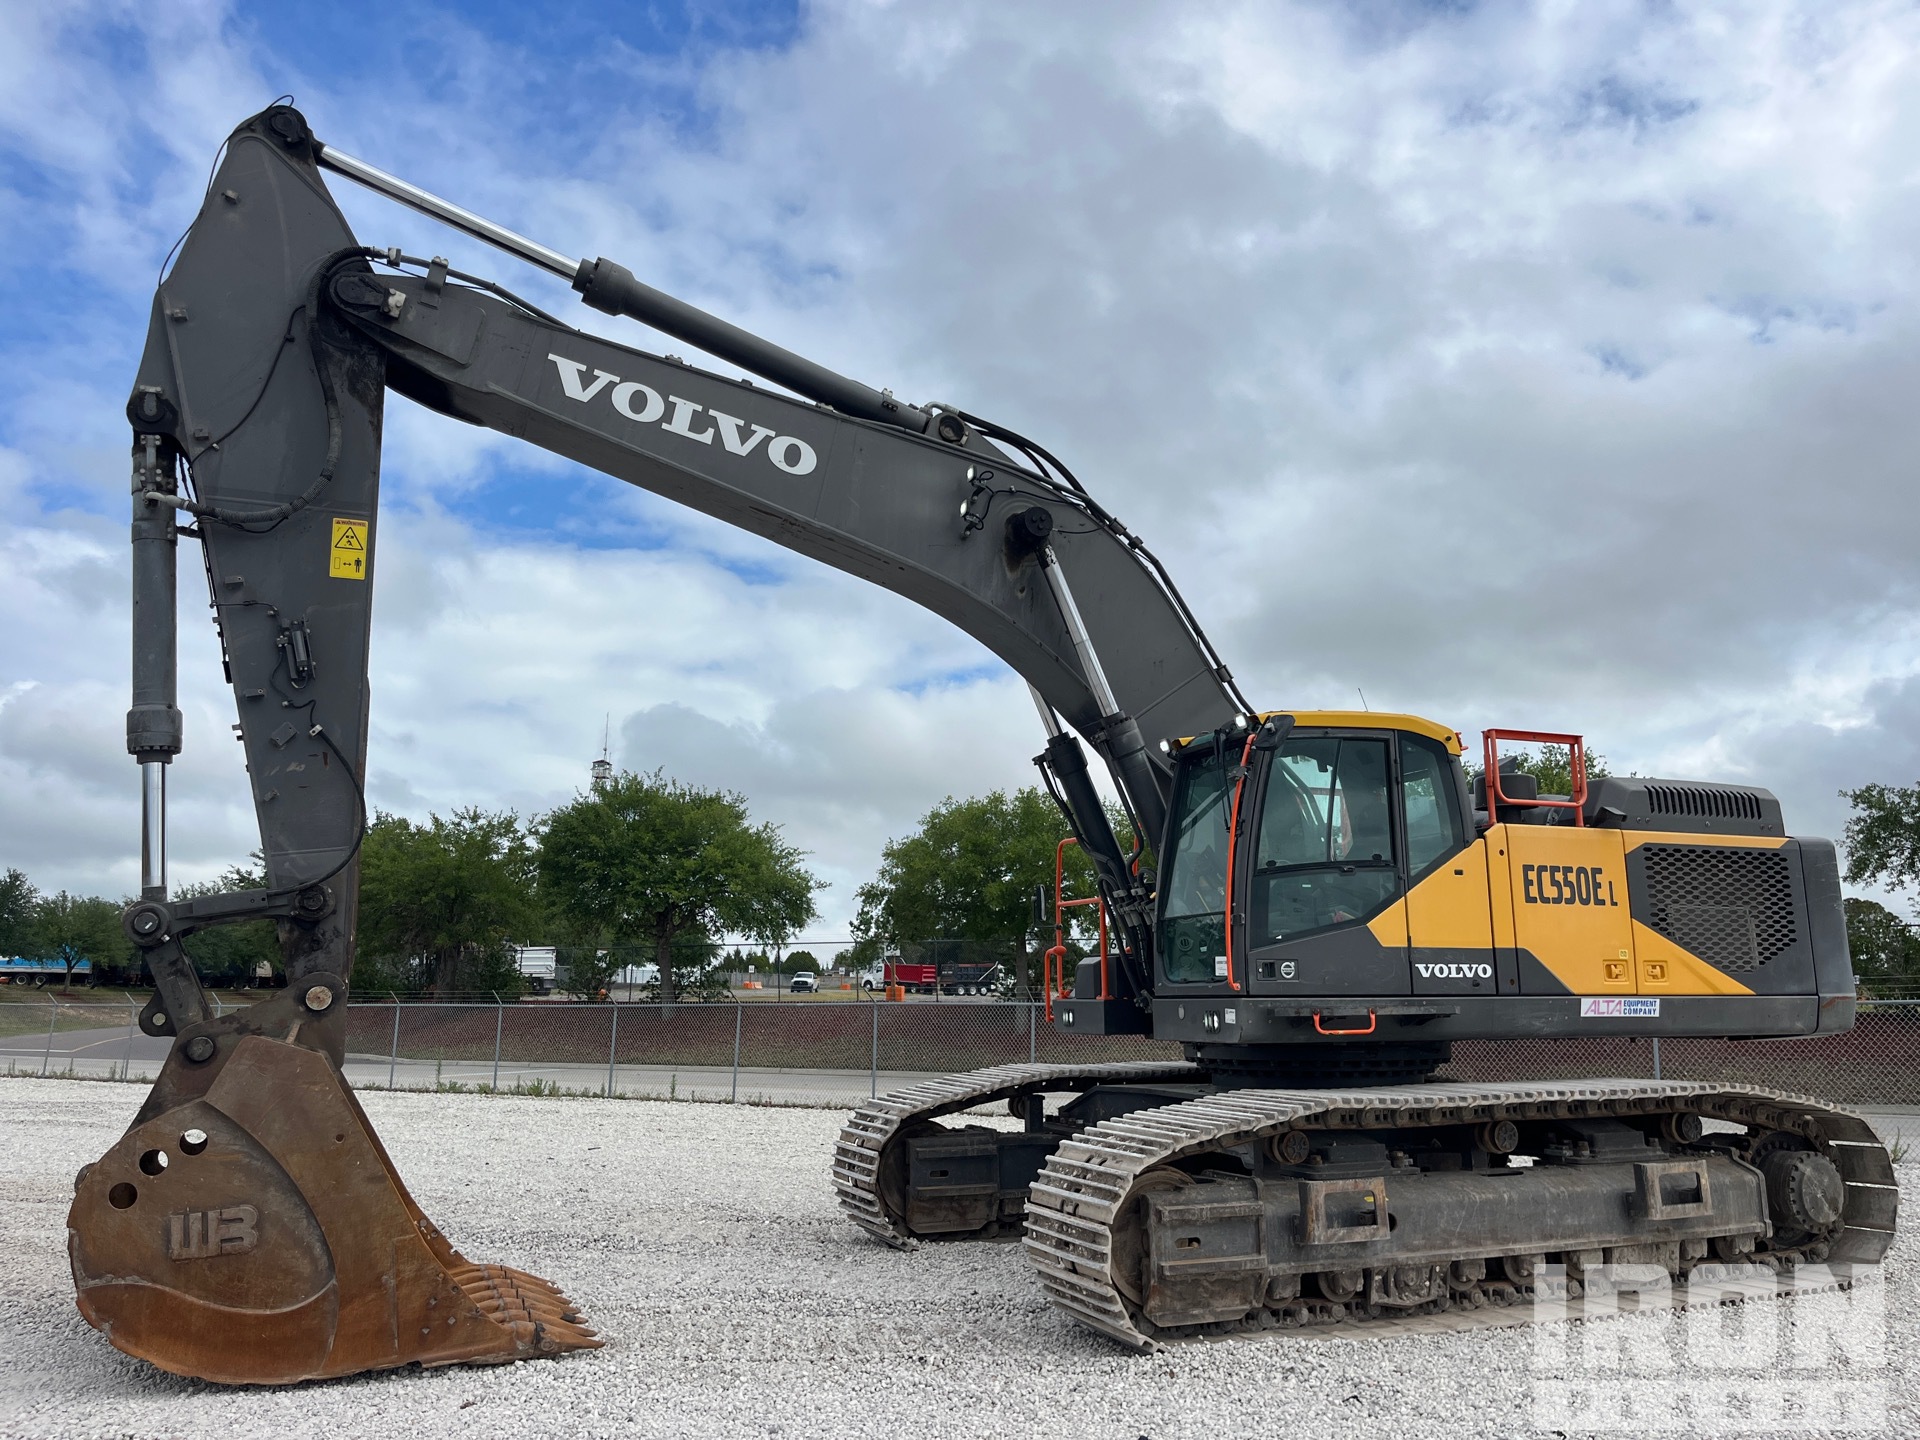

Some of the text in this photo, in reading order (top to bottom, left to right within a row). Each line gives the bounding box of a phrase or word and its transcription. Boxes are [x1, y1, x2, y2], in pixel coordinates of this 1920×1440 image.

[547, 352, 818, 476] VOLVO
[1522, 864, 1606, 906] EC550E
[1415, 963, 1492, 978] VOLVO
[1584, 999, 1657, 1015] ALTA EQUIPMENT
